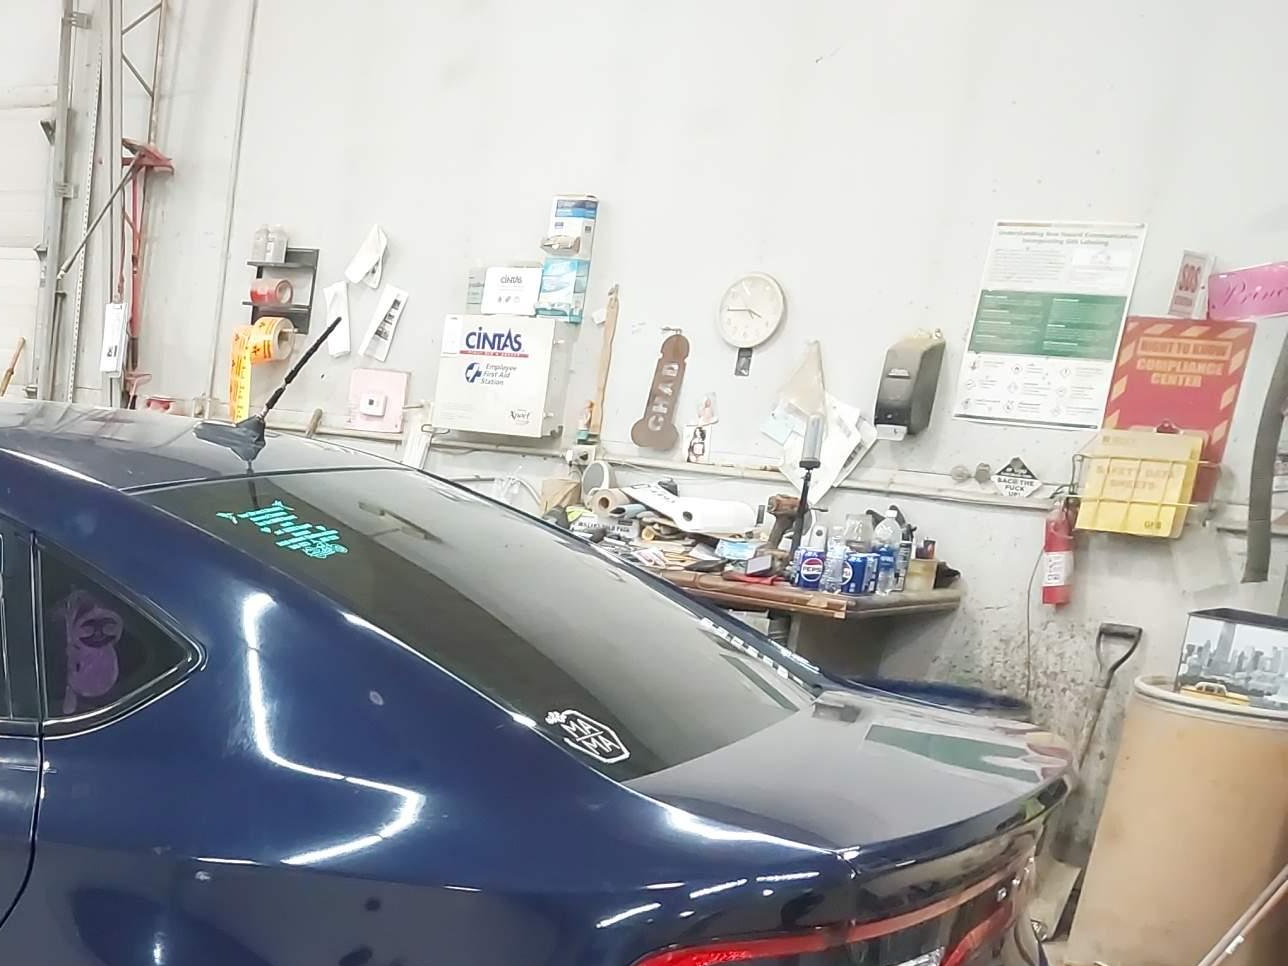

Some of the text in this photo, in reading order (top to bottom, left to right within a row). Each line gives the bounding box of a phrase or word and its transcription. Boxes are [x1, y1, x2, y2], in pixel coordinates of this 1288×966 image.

[485, 363, 517, 373] Employee
[1136, 358, 1224, 376] COMPLIANCE
[1150, 372, 1202, 387] CENTER
